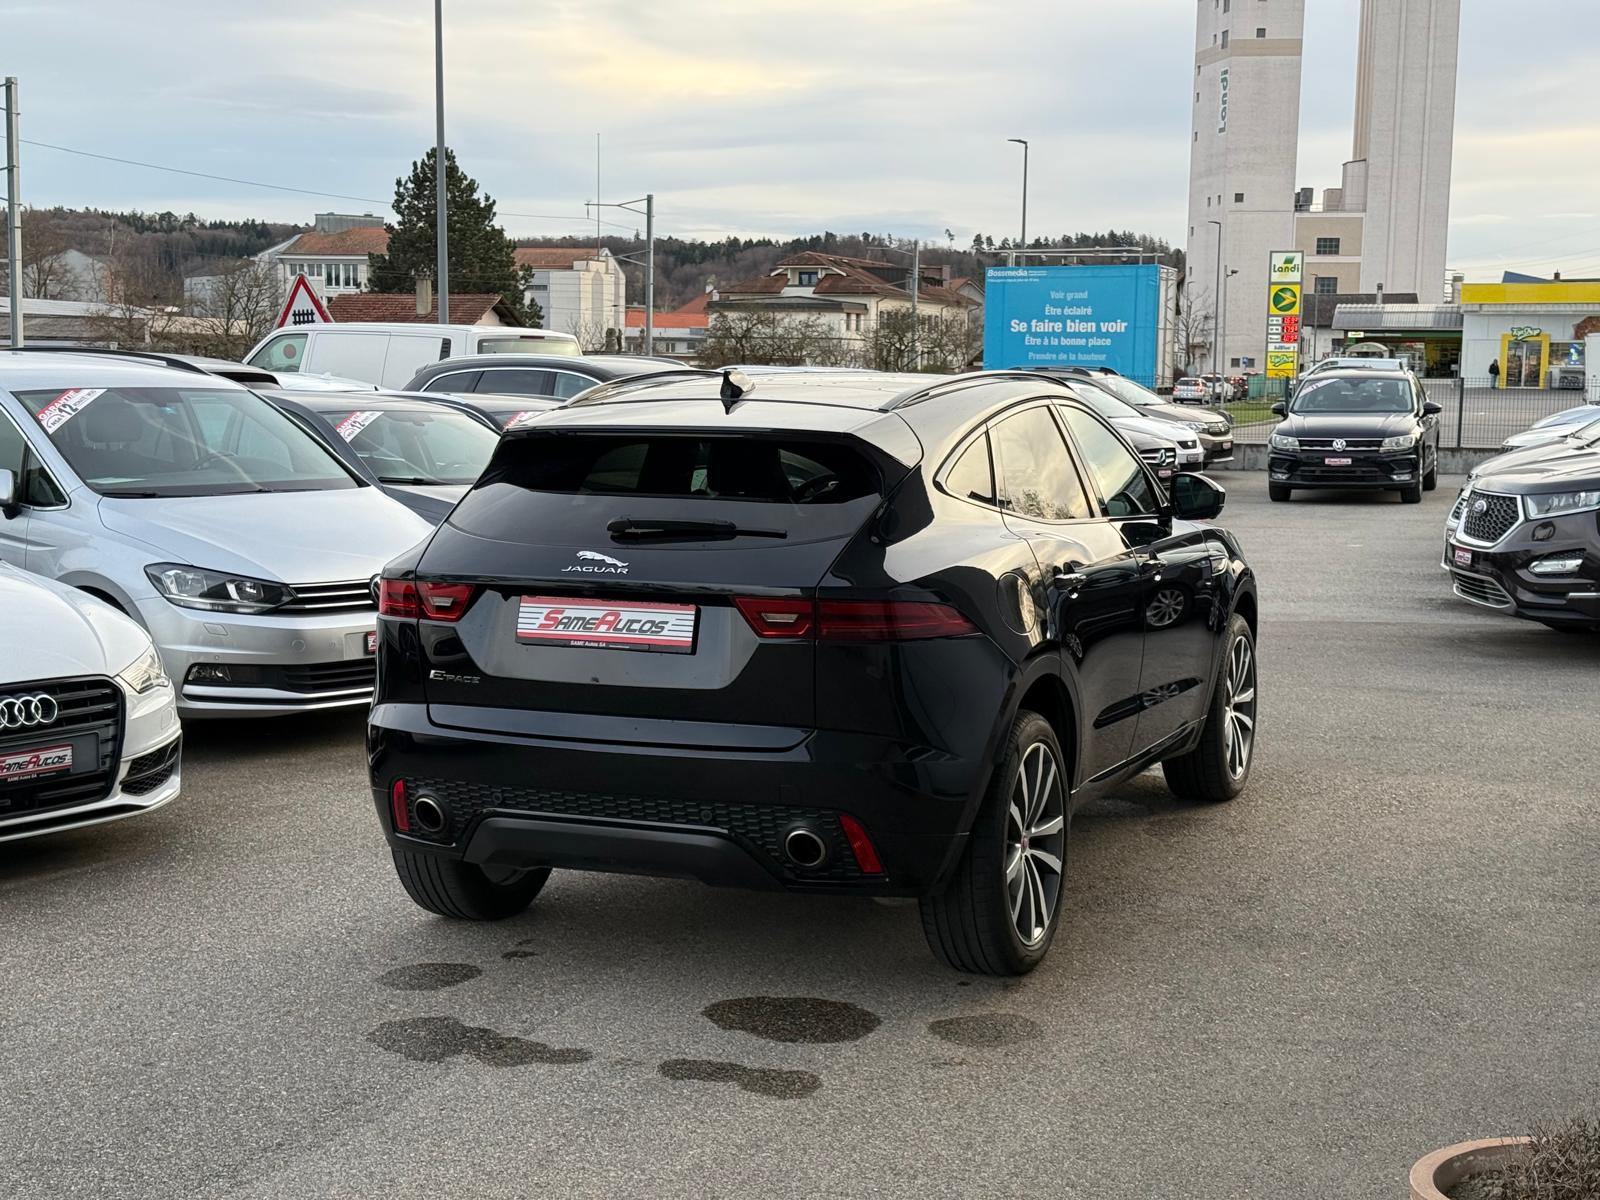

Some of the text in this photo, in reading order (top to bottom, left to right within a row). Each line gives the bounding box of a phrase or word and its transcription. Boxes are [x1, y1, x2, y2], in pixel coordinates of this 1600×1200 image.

[1218, 69, 1229, 134] Landi
[987, 269, 1028, 277] Bossmedia
[1273, 264, 1300, 273] Landi
[1050, 290, 1089, 301] Voir grand
[1045, 304, 1092, 315] Être éclairé
[1010, 319, 1128, 333] Se faire bien voir
[1025, 335, 1112, 348] Être à la bonne place
[1028, 352, 1107, 361] Prendre de la hauteur
[58, 403, 79, 416] 12
[561, 566, 629, 575] JAGUAR
